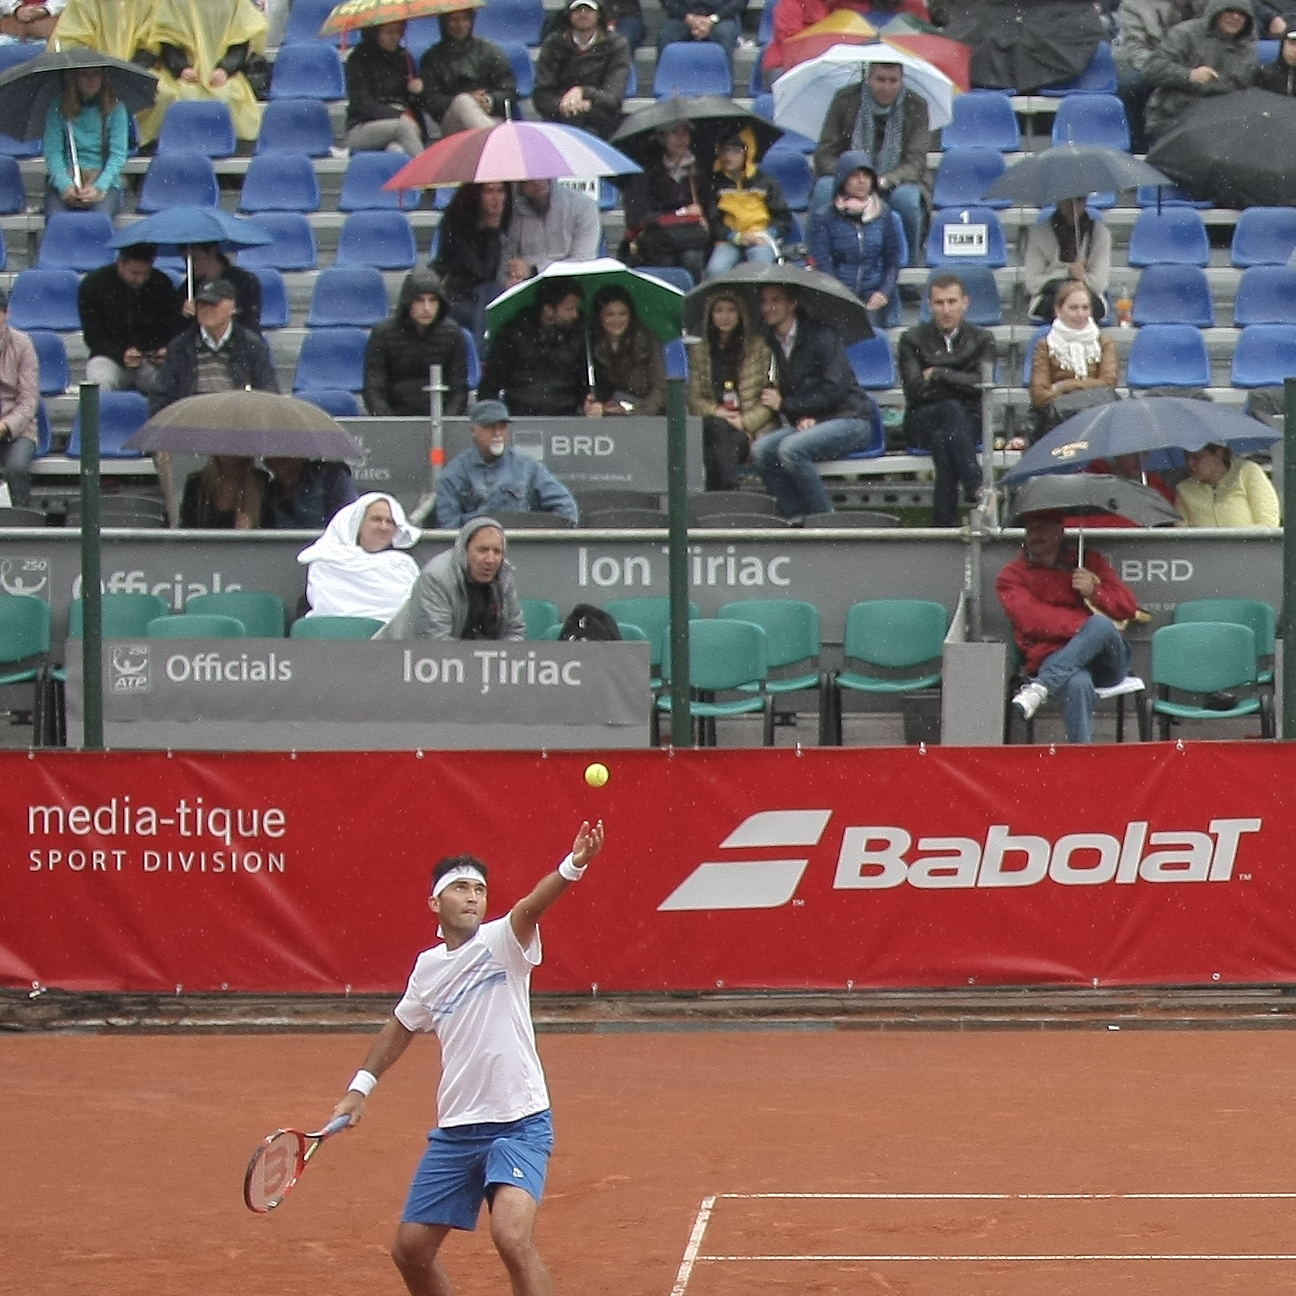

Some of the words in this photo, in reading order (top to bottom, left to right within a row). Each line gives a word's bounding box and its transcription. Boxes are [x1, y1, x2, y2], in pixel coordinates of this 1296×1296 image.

[959, 210, 968, 223] 1
[551, 436, 615, 455] BRD
[578, 547, 651, 586] Ion
[1121, 560, 1194, 582] BRD
[166, 653, 292, 682] Officials
[403, 650, 464, 683] Ion
[115, 677, 147, 690] ATP
[28, 796, 286, 846] media-tique
[29, 850, 126, 871] SPORT
[144, 851, 285, 873] DIVISION
